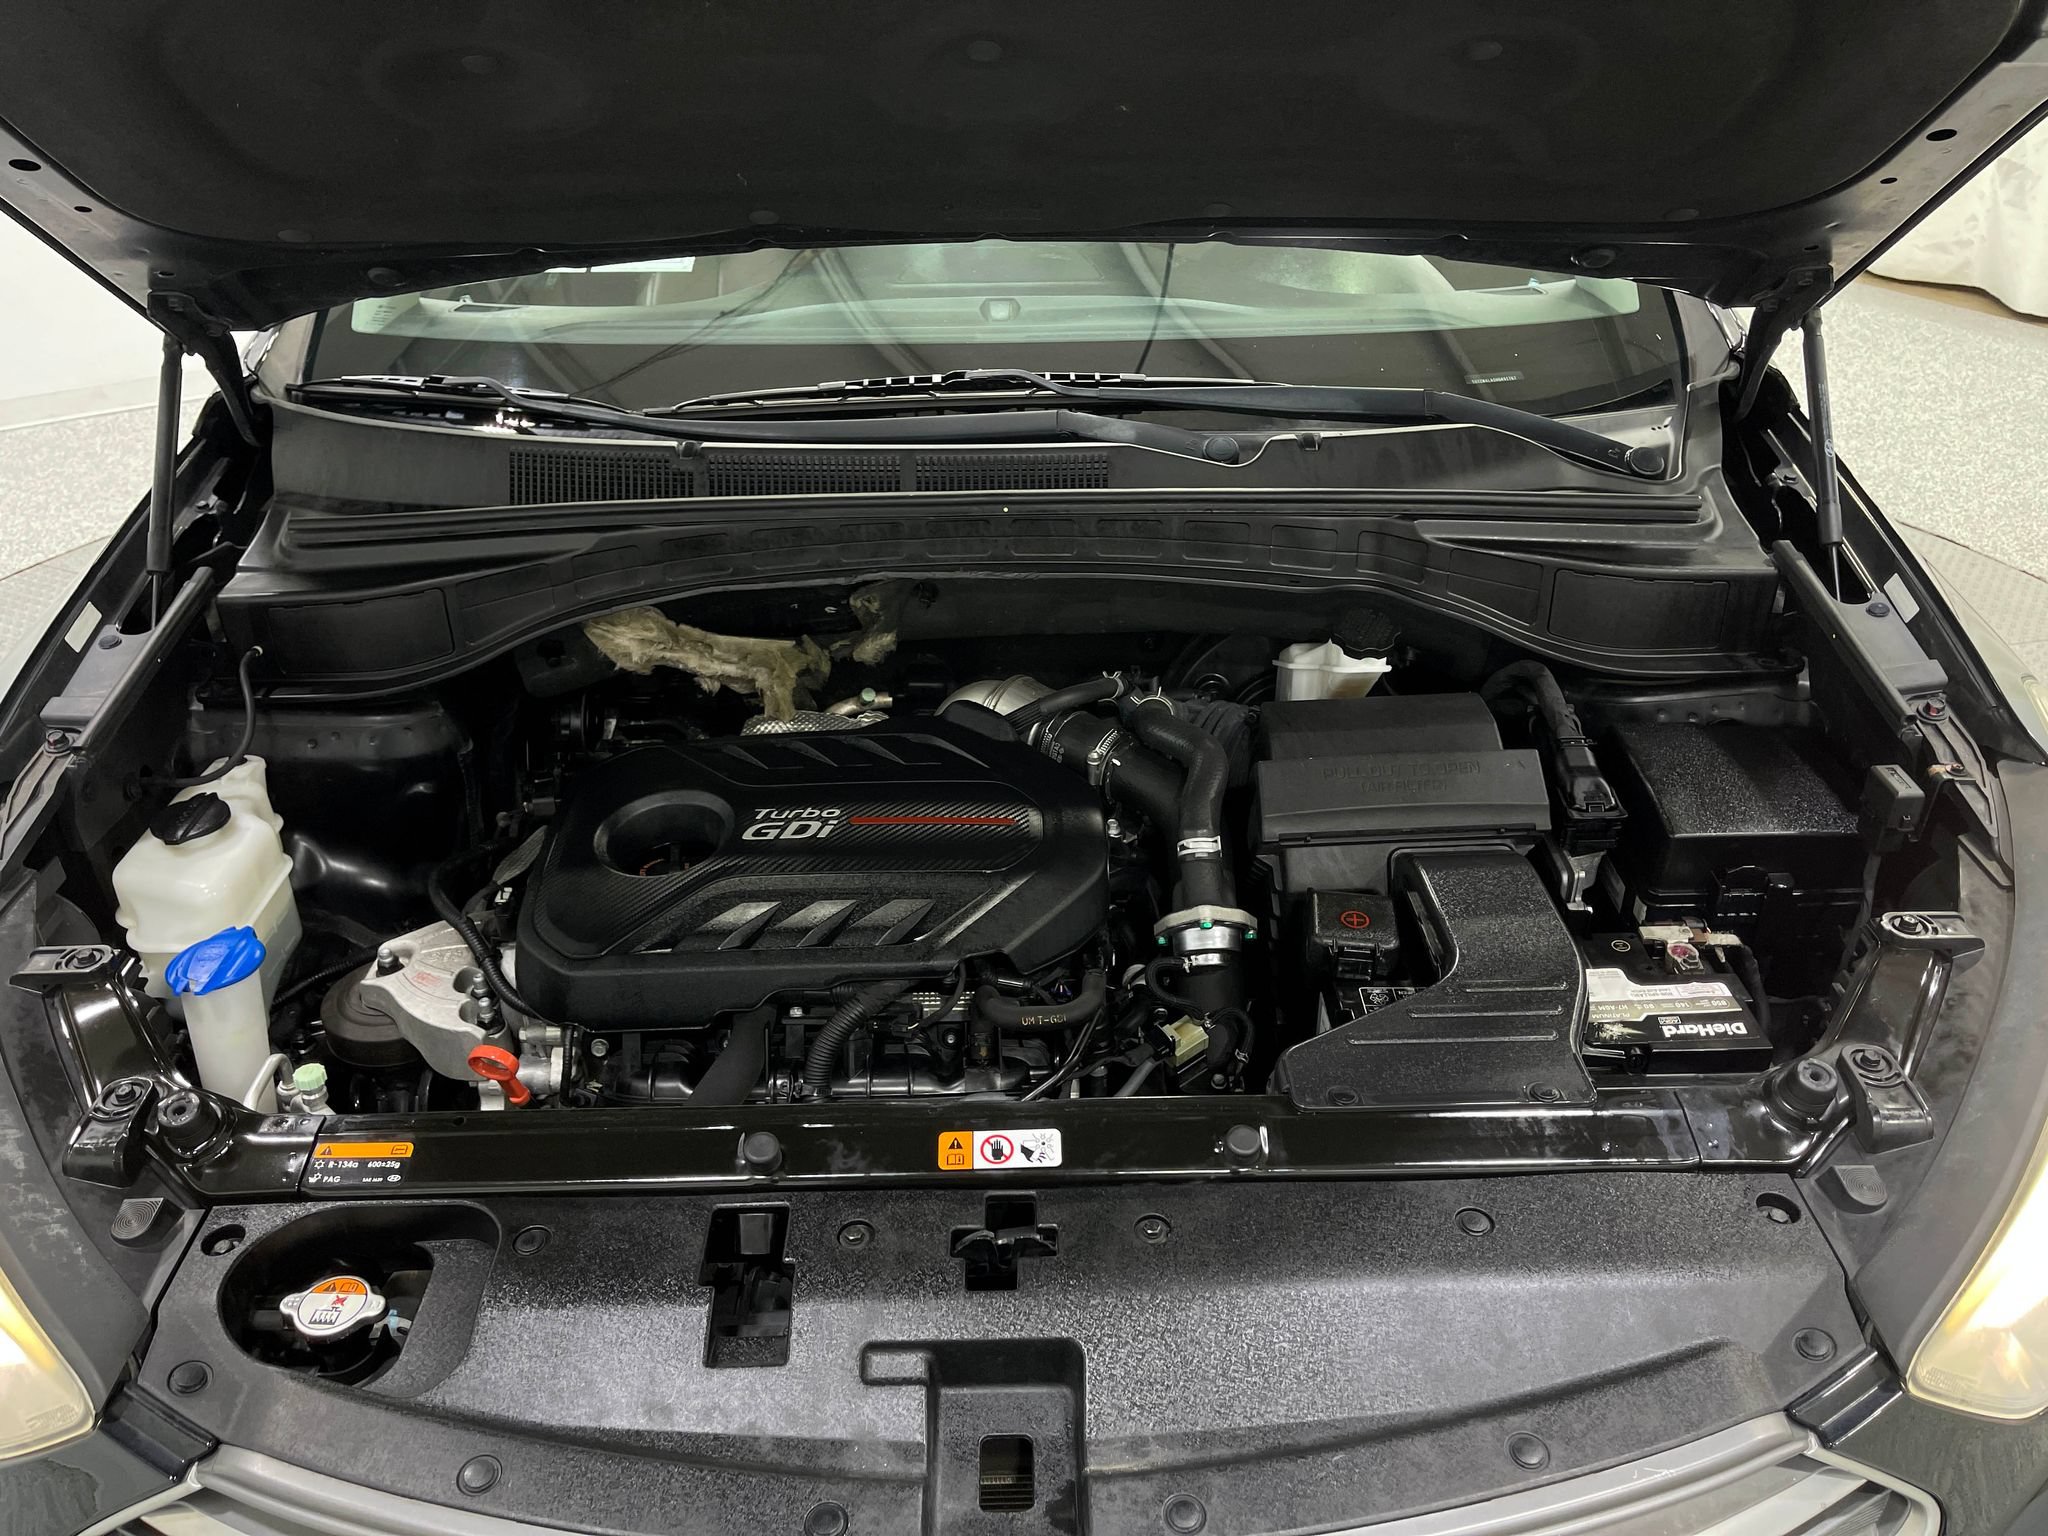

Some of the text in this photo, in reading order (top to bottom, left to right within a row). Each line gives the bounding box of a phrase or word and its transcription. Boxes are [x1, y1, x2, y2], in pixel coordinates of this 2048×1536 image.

[754, 806, 841, 820] Turbo
[742, 819, 840, 841] GDi
[1662, 1022, 1748, 1038] DieHard
